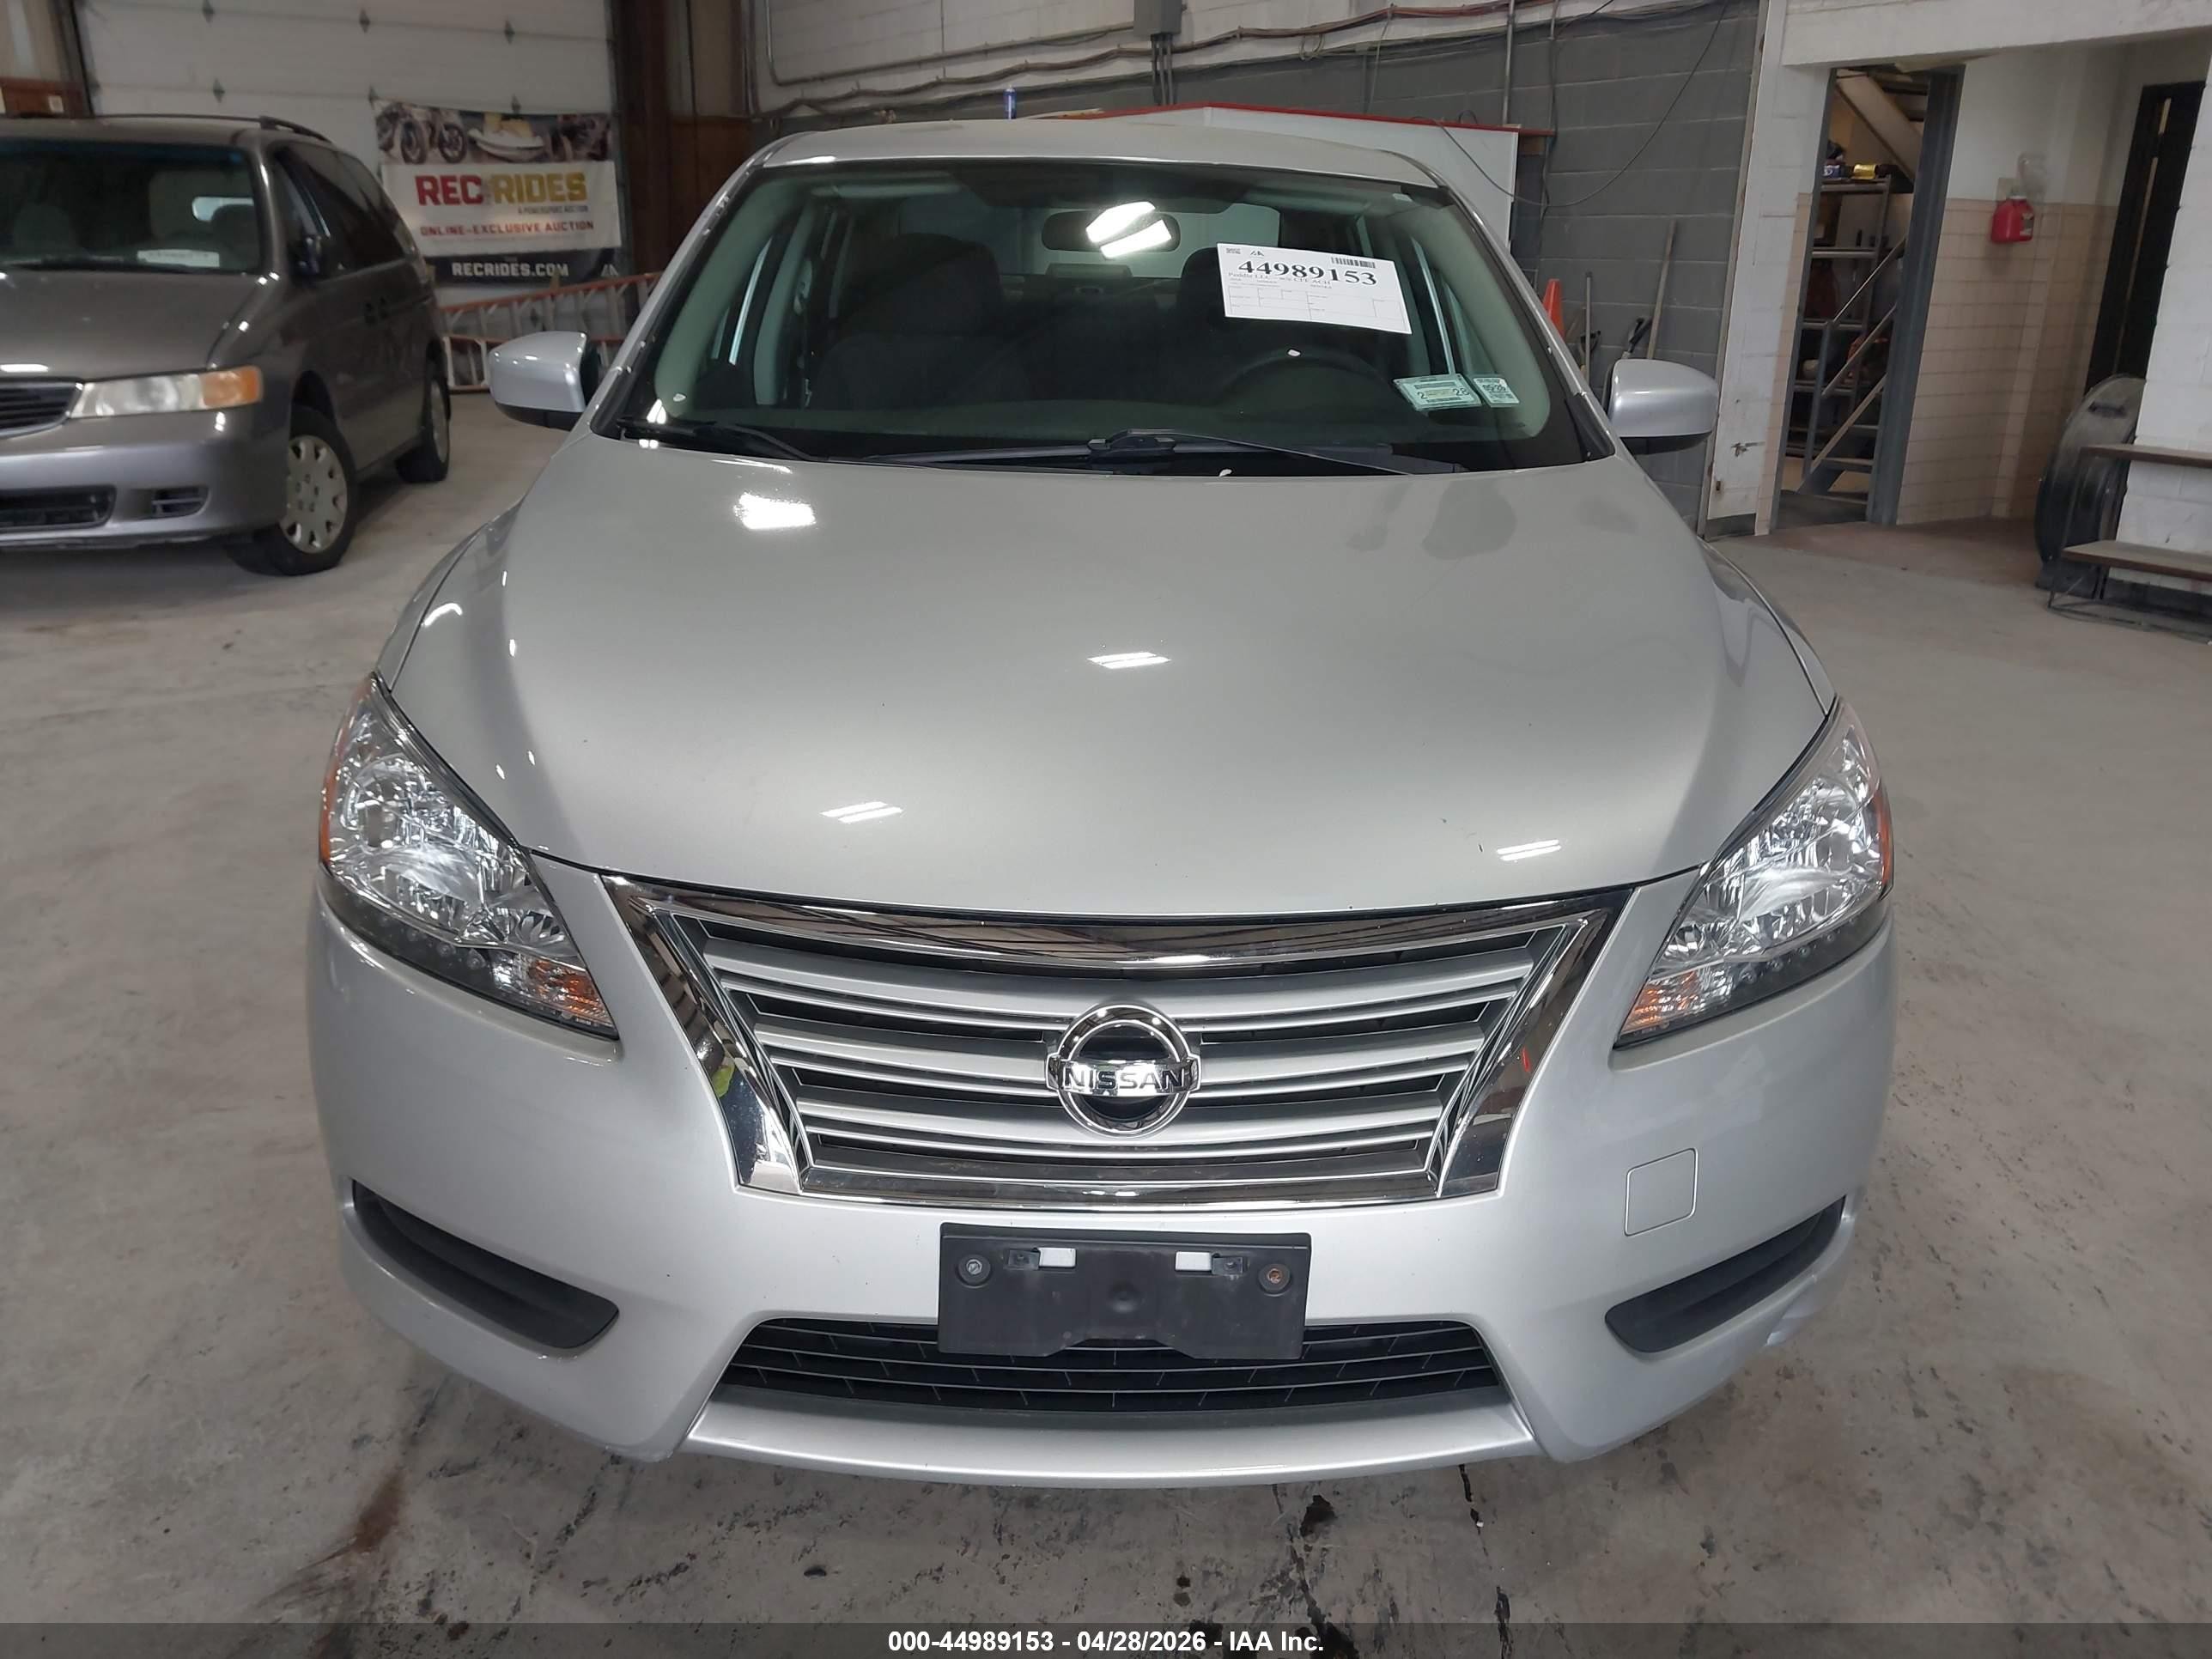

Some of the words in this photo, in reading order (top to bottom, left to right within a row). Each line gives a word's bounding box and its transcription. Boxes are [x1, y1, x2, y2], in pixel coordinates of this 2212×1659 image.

[416, 175, 483, 205] REC
[491, 173, 587, 204] RIDES
[420, 223, 541, 236] ONLINE-EXCLUSIVE
[544, 220, 595, 232] AUCTION
[452, 262, 569, 276] RECRIDES.COM
[1238, 260, 1377, 286] 44989153
[1062, 1069, 1184, 1091] NISSAN
